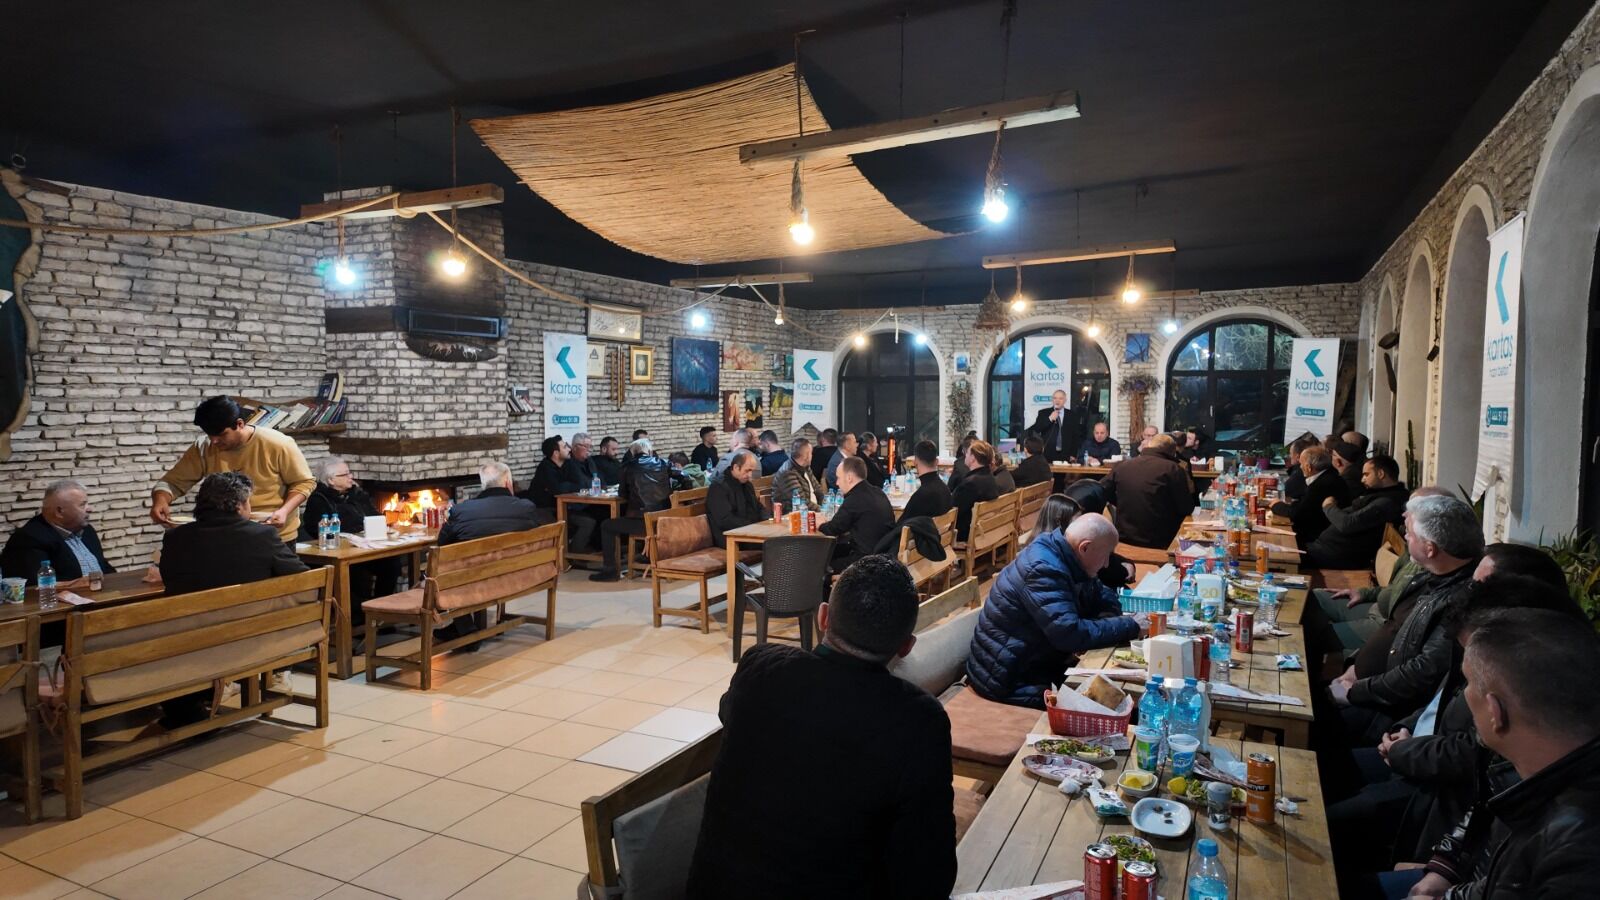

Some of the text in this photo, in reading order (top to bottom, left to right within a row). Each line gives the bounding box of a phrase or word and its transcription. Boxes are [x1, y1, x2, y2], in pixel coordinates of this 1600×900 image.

[1487, 334, 1513, 366] kartaş
[1030, 371, 1065, 384] kartaş
[550, 380, 583, 398] kartaş
[797, 381, 827, 393] kartaş
[1295, 379, 1330, 394] kartaş
[1201, 587, 1218, 598] 20
